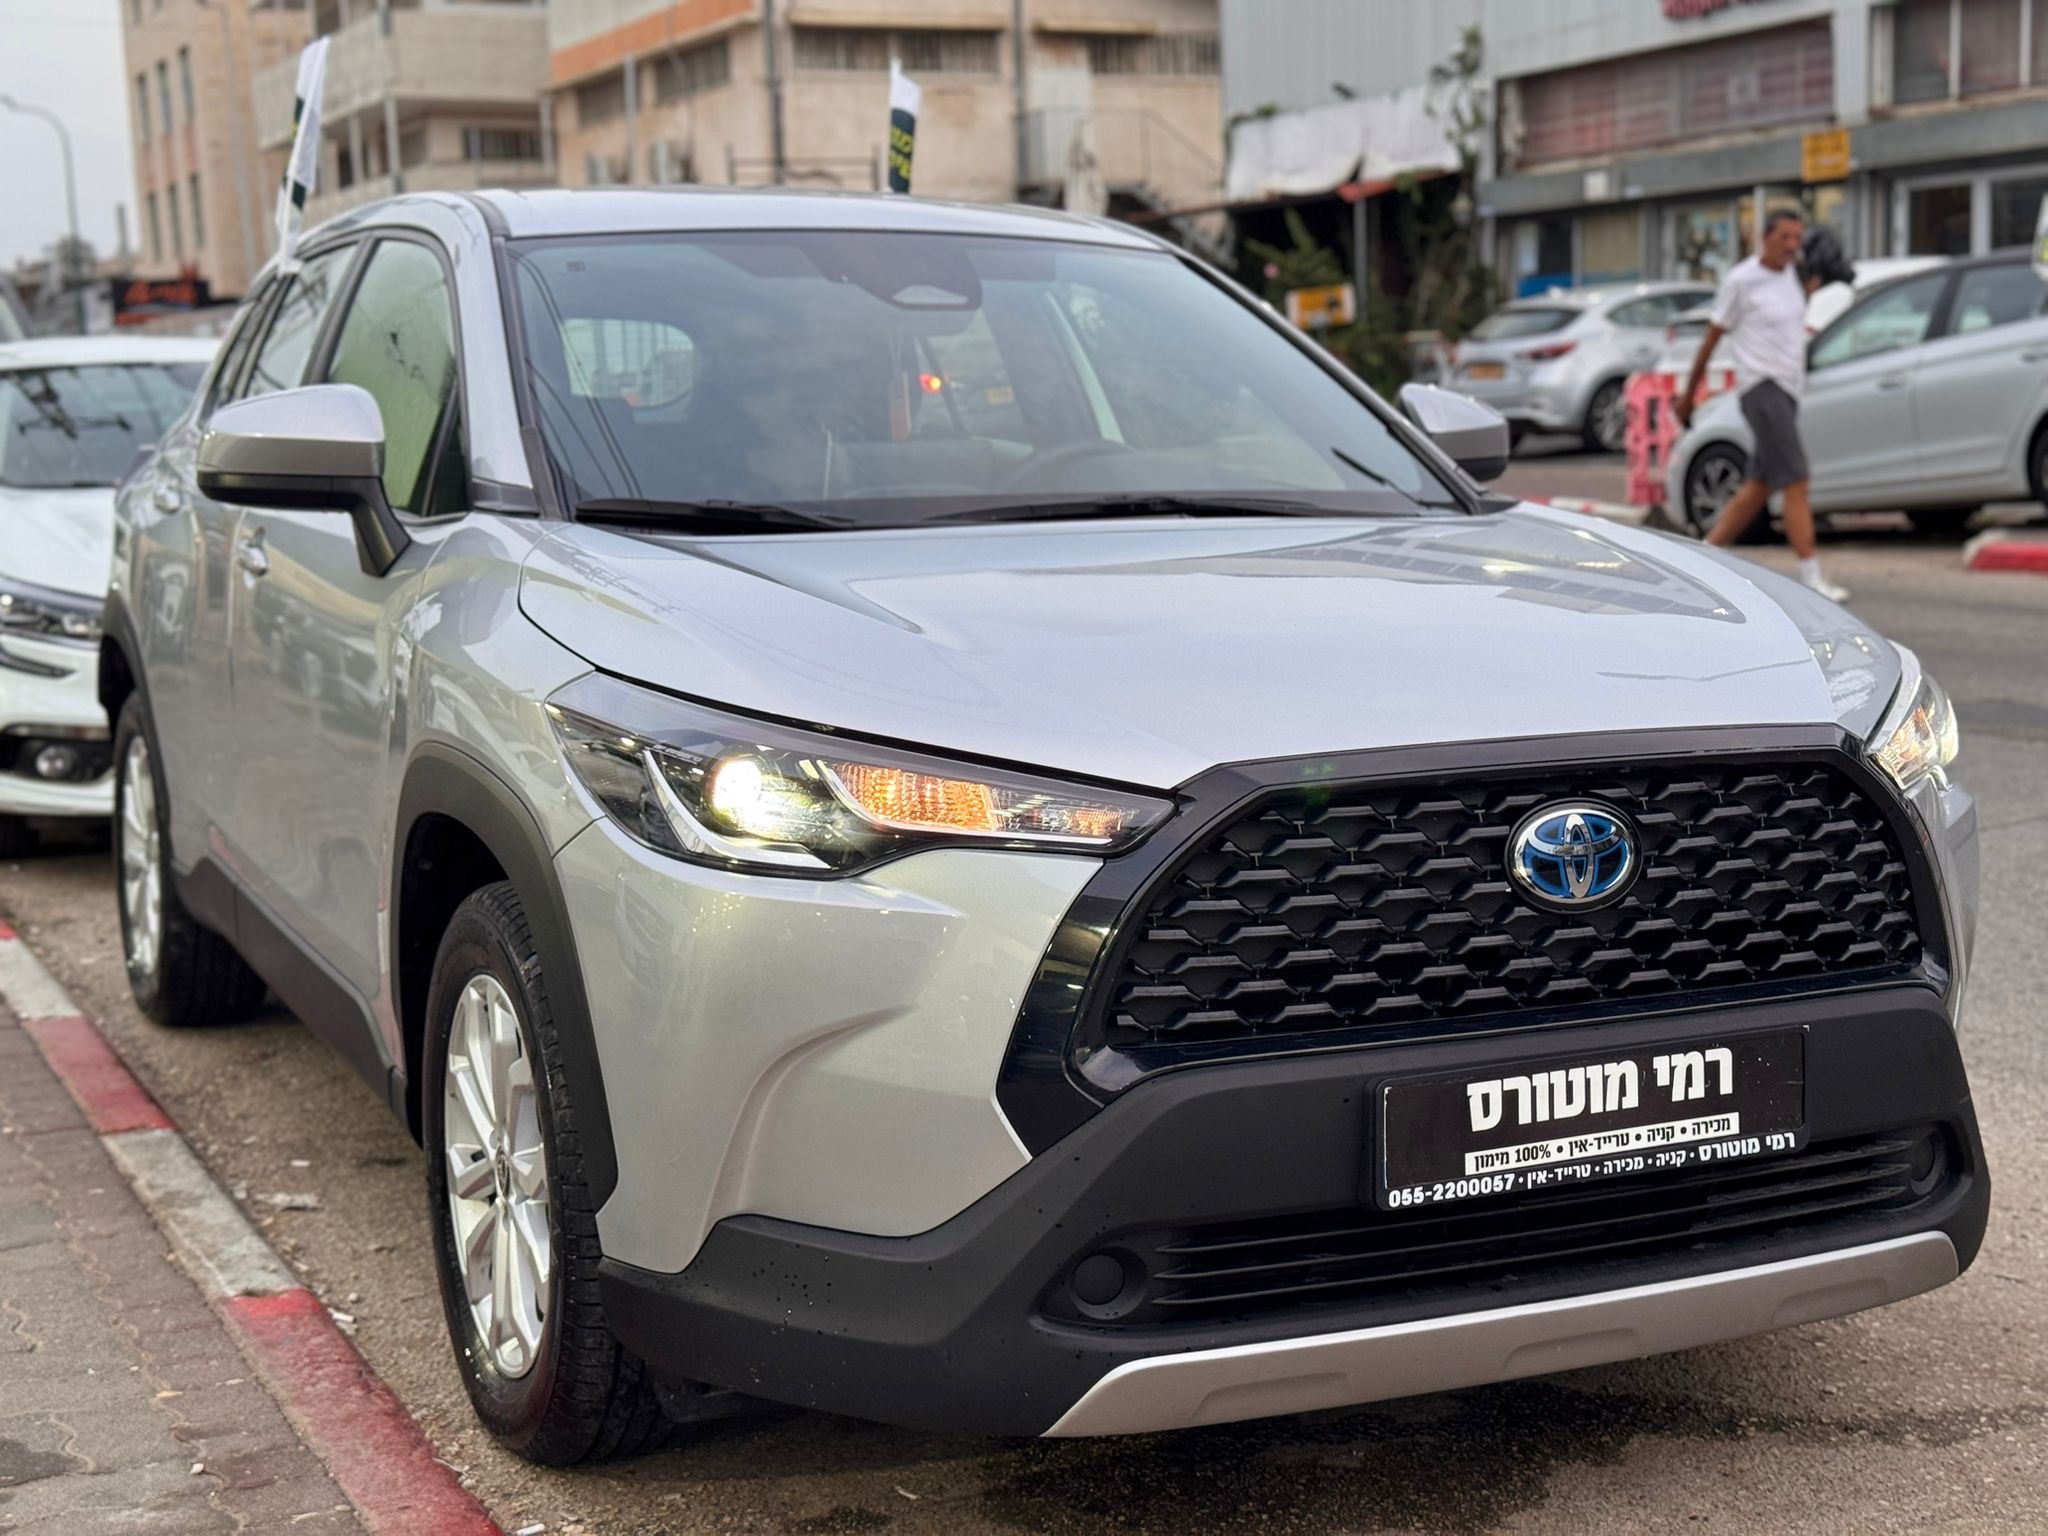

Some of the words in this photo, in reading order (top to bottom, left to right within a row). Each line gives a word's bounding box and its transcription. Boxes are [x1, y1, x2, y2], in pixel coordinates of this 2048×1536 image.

[1652, 1047, 1733, 1102] רמי
[1467, 1060, 1639, 1132] מוטורס
[1647, 1126, 1675, 1143] קניה
[1691, 1117, 1731, 1136] מכירה
[1568, 1132, 1630, 1157] טרייד-אין
[1699, 1137, 1761, 1161] מוטורס
[1765, 1132, 1796, 1150] רמי
[1474, 1152, 1510, 1172] מימון
[1514, 1144, 1551, 1163] 100%
[1656, 1150, 1686, 1168] קניה
[1603, 1156, 1644, 1175] מכירה
[1527, 1163, 1591, 1189] טרייד-אין
[1388, 1173, 1515, 1208] 055-2200057
